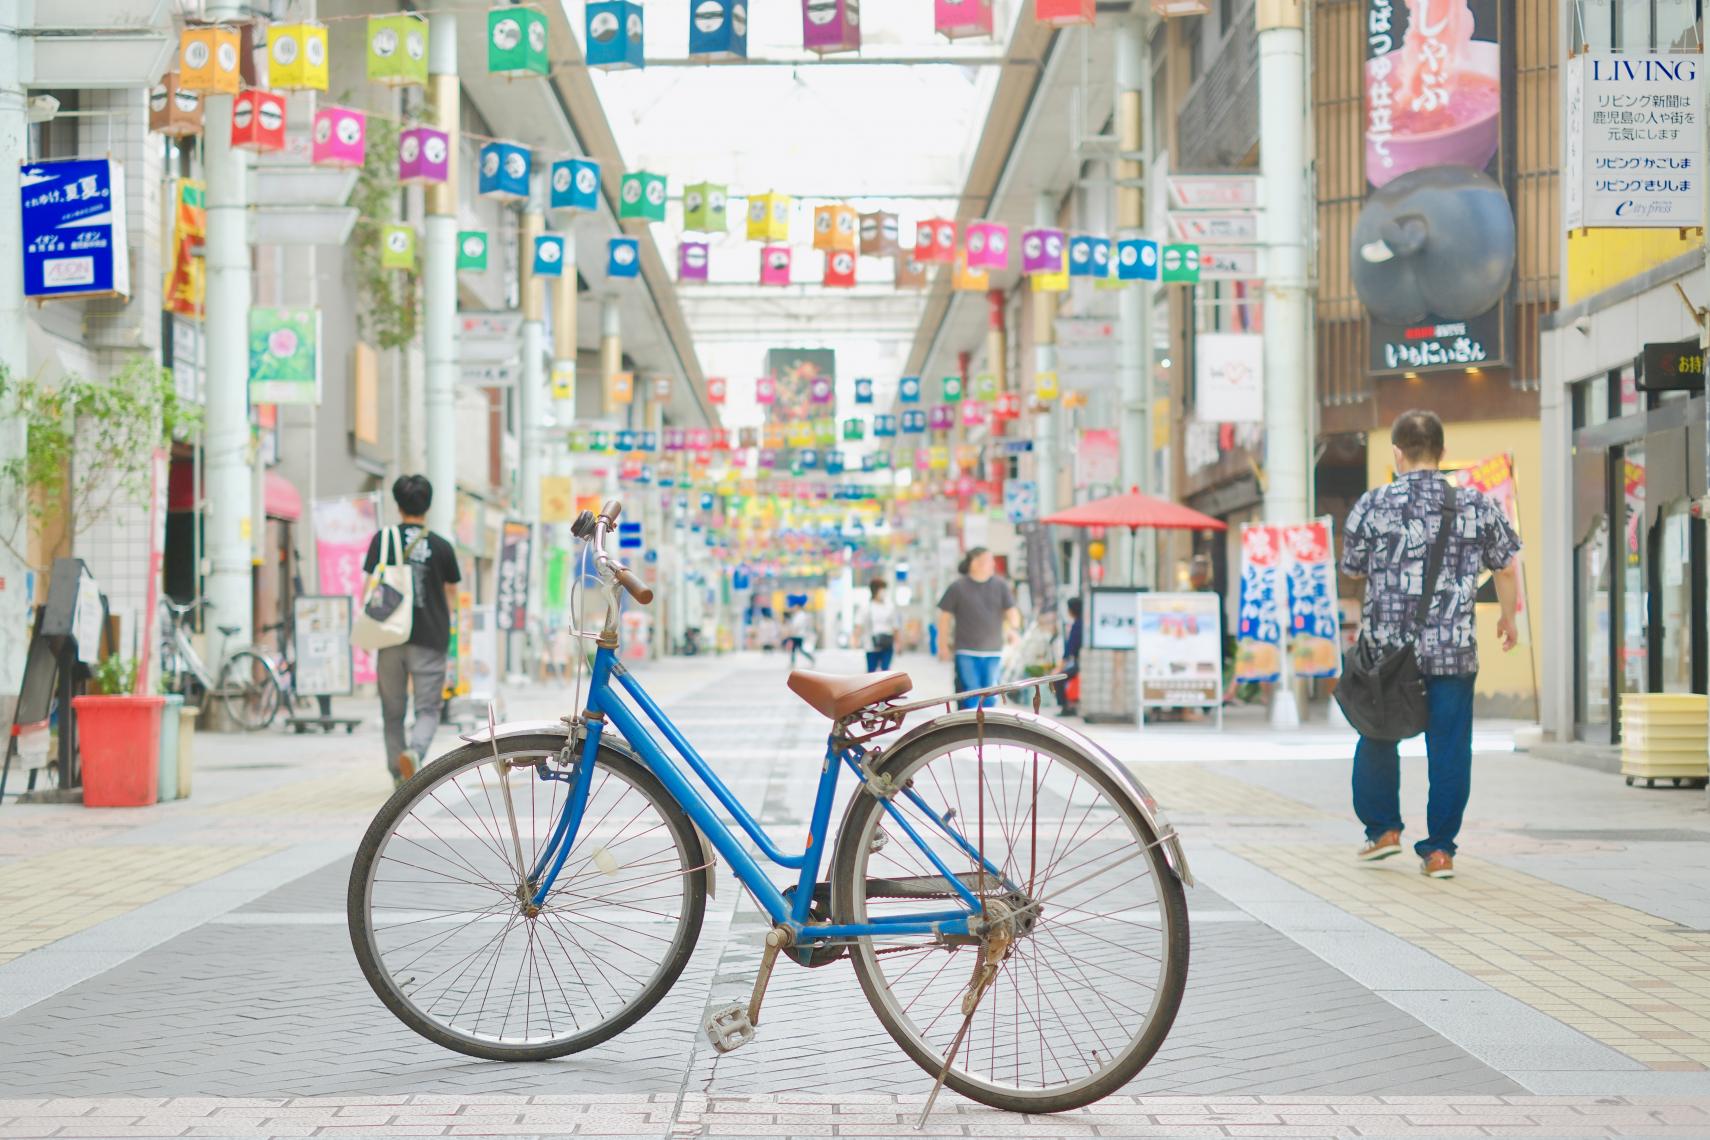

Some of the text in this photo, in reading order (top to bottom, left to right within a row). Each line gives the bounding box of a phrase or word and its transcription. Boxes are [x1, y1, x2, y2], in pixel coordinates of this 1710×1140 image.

[1593, 59, 1695, 81] LIVING
[1368, 0, 1392, 168] ばつゆ仕立て。
[1598, 94, 1691, 109] リビング新聞は
[1592, 110, 1696, 125] 鹿児島の人や街を
[1607, 127, 1681, 141] 元気にします
